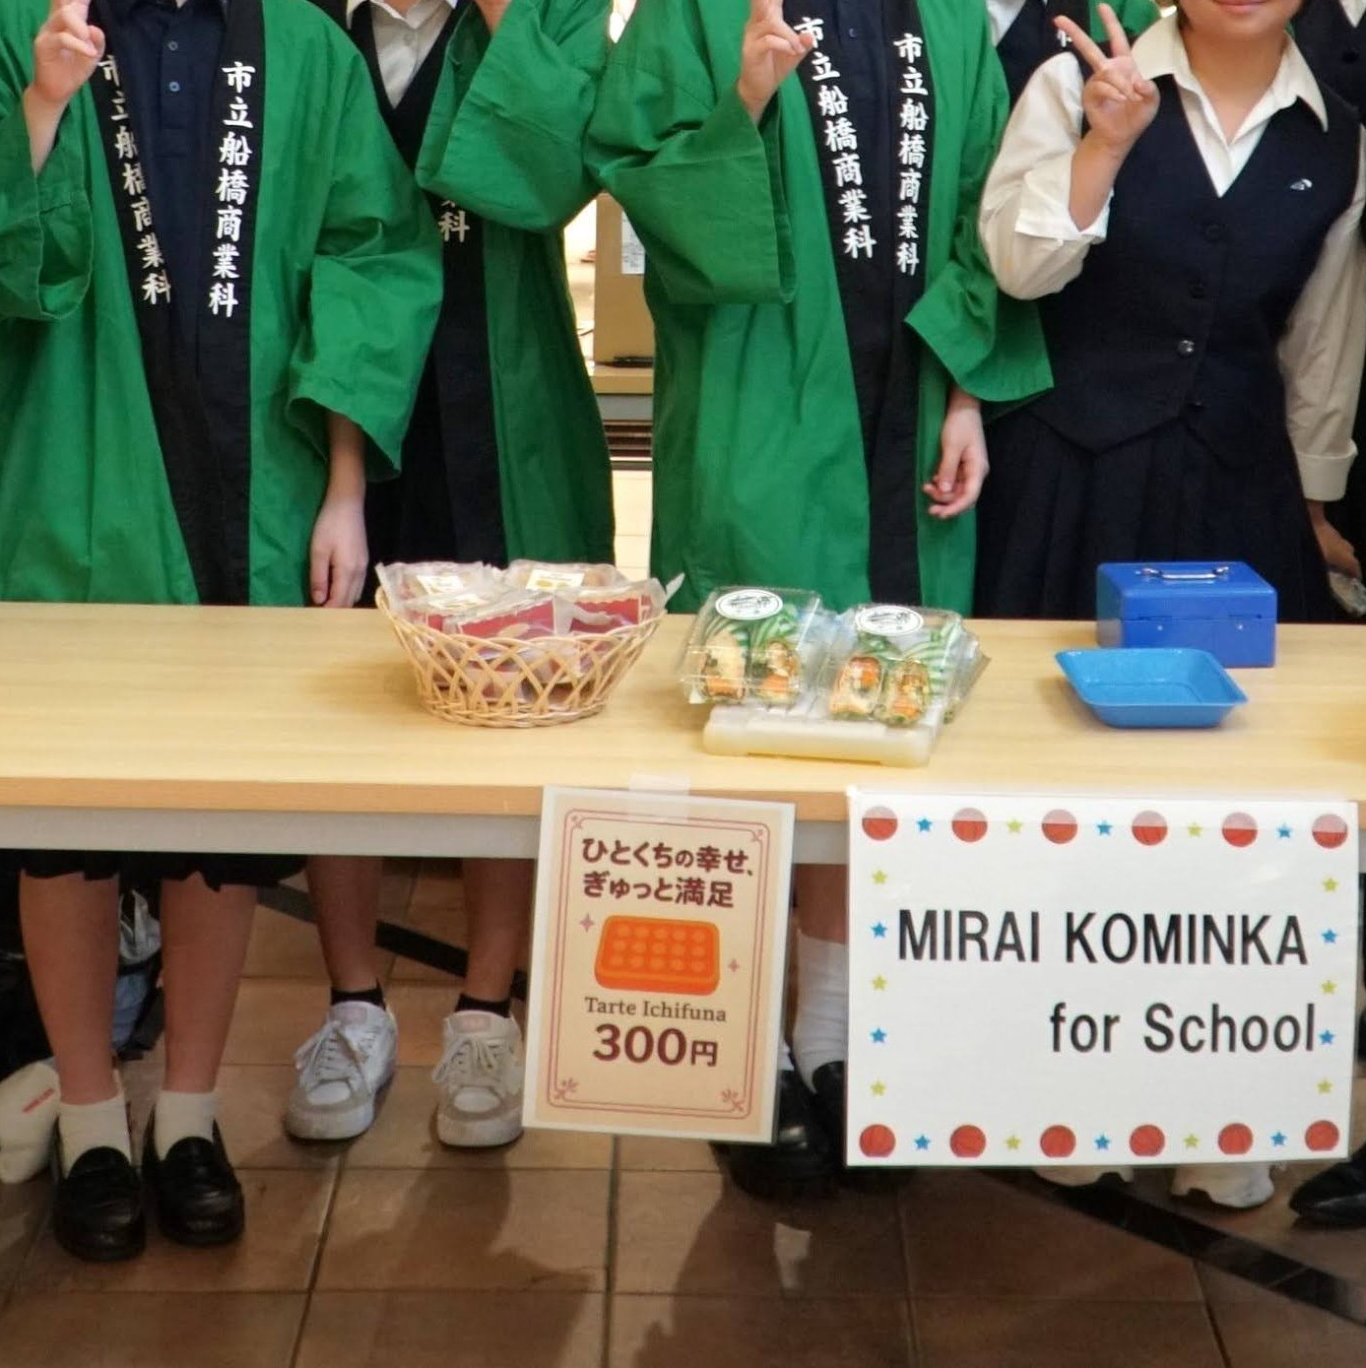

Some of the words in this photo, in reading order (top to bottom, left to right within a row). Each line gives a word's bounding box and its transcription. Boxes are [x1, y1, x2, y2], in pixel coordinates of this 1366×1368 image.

[794, 17, 877, 259] 市立船橋商業科
[894, 33, 930, 275] 市立船橋商業科
[208, 61, 257, 318] 市立船橋商業科
[581, 870, 735, 909] ぎゅっと満足
[896, 908, 1041, 963] MIRAI
[1064, 911, 1310, 966] KOMINKA
[584, 994, 638, 1017] Tarte
[642, 998, 728, 1024] Ichifuna
[1050, 1002, 1121, 1054] for
[1143, 1002, 1318, 1055] School
[591, 1022, 720, 1068] 300円
